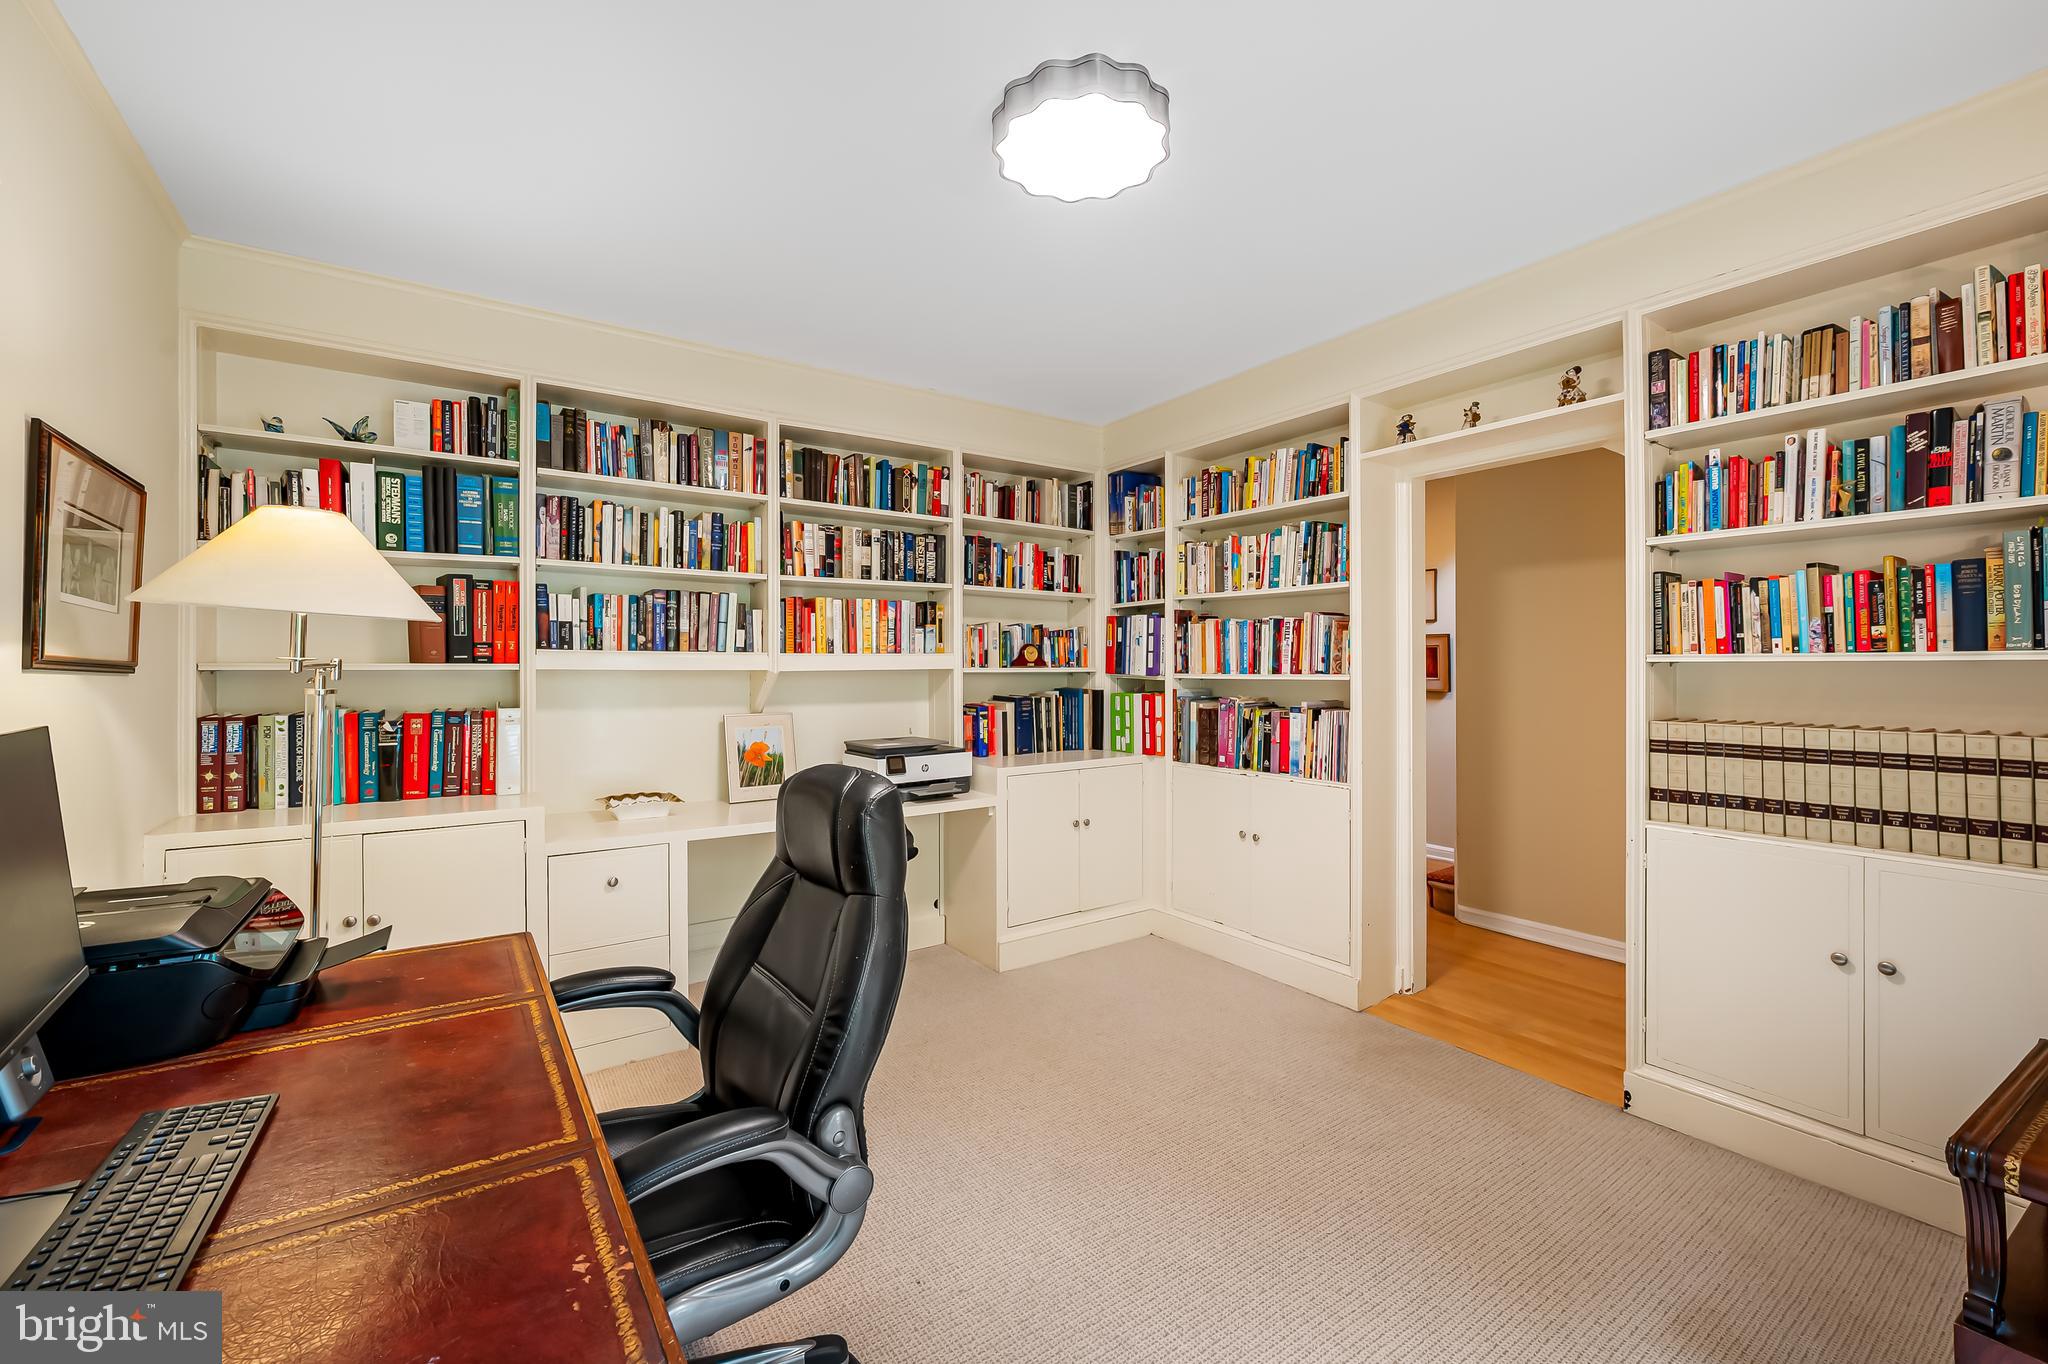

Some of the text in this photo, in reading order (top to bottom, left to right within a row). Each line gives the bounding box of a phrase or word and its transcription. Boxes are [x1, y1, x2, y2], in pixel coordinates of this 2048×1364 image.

[2027, 284, 2039, 308] Moyes
[1881, 325, 1890, 343] Singing
[1991, 407, 2004, 446] MARTIN
[2005, 406, 2015, 430] GEORGE
[2039, 418, 2047, 427] GOOD
[509, 420, 517, 450] POETRY
[1857, 453, 1865, 469] CIVIL
[1857, 471, 1865, 492] ACTION
[1992, 464, 2000, 490] DRAGONS
[2003, 469, 2011, 488] DANCE
[392, 478, 401, 524] STEDMAN'S
[2016, 536, 2025, 567] LYRICS
[1899, 580, 1909, 599] Capture
[1994, 564, 2005, 616] HARRY POTTER
[2013, 584, 2022, 624] BOB DYLAN
[232, 724, 240, 753] INTERNAL
[263, 726, 271, 738] PDR
[363, 731, 371, 775] Gastroenterology
